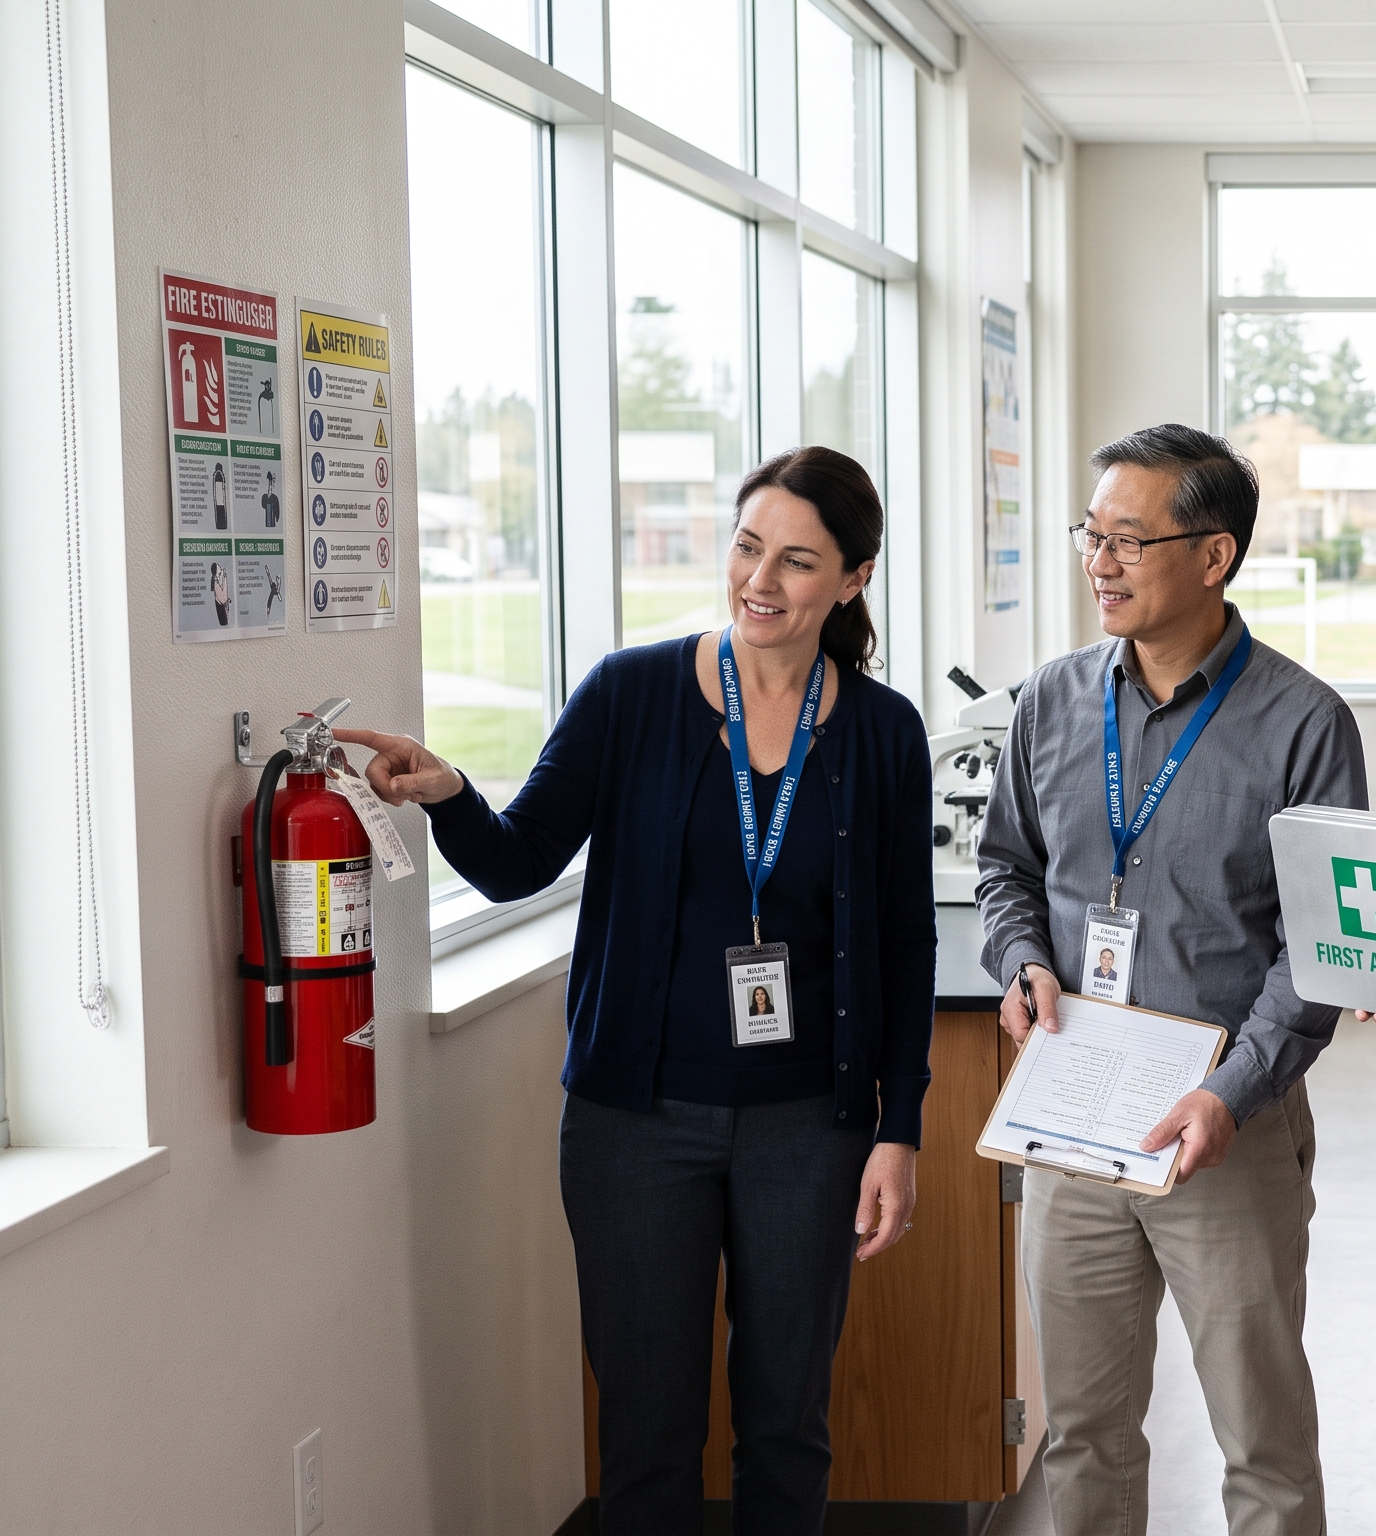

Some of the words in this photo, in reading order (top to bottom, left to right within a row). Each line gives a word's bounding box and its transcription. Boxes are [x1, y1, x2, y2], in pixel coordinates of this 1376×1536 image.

[168, 285, 198, 317] FIRE
[321, 328, 357, 355] SAFETY
[358, 336, 387, 361] RULES
[1316, 942, 1364, 970] FIRST
